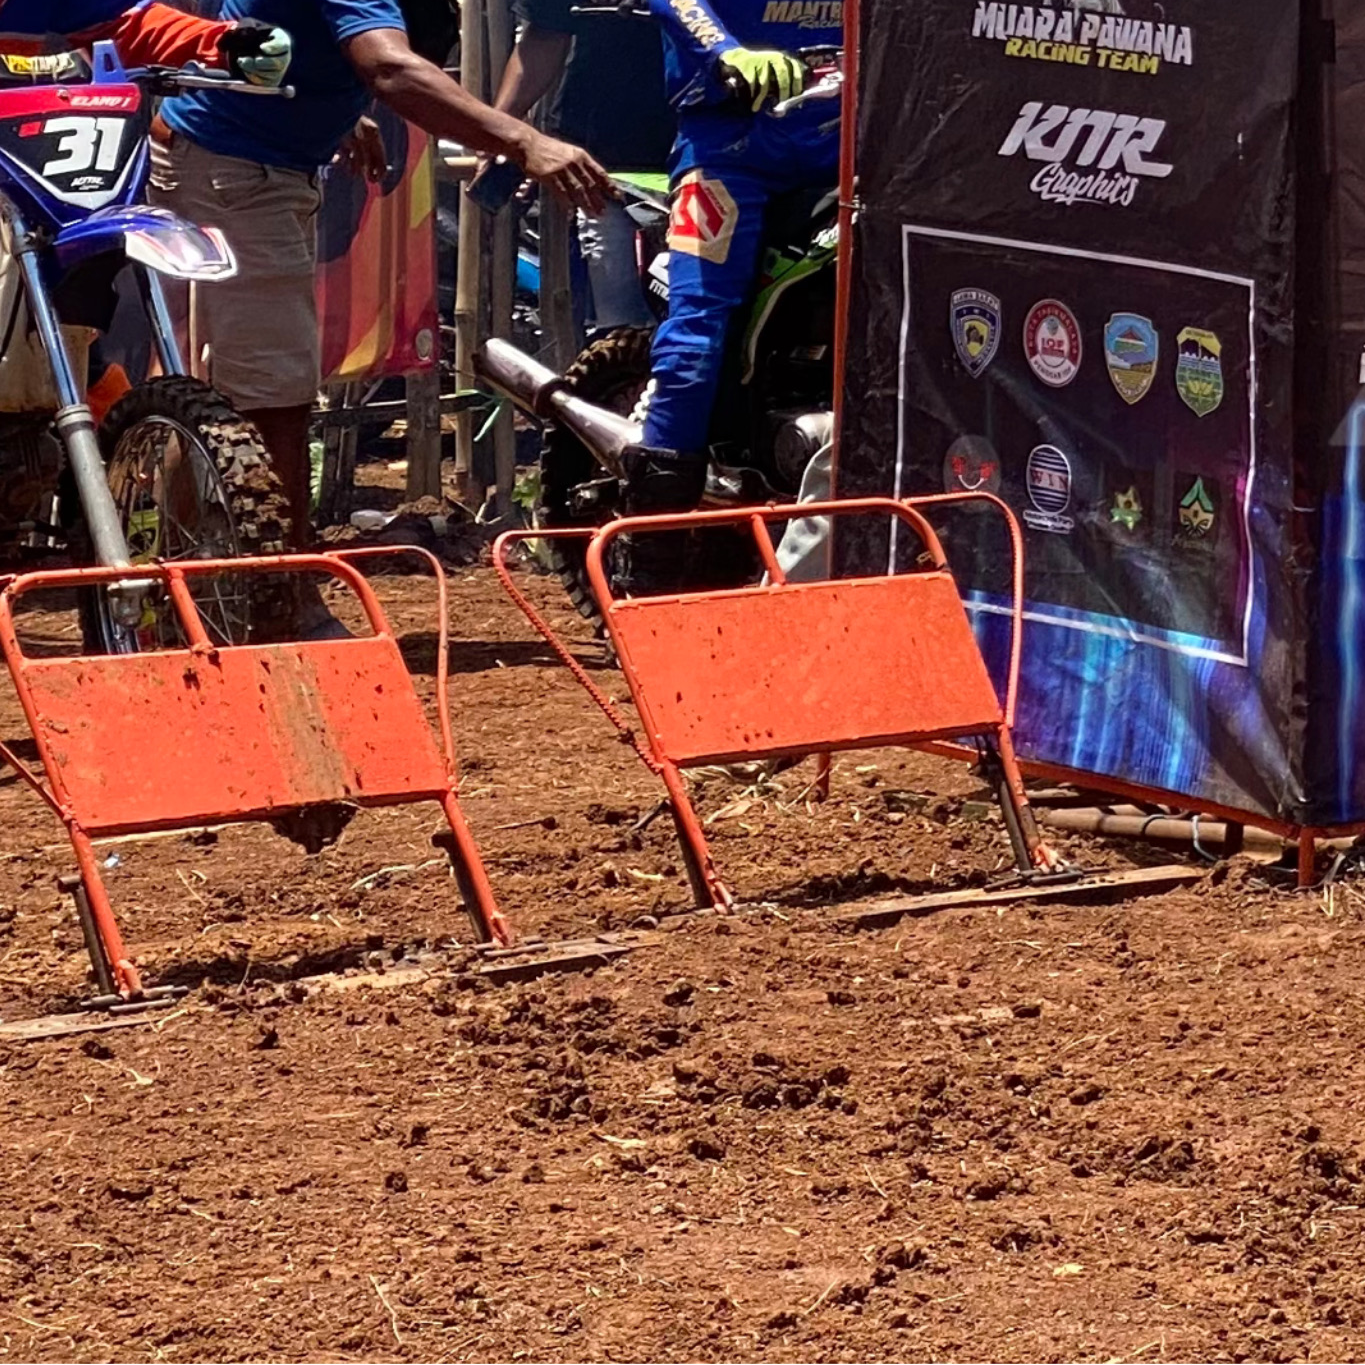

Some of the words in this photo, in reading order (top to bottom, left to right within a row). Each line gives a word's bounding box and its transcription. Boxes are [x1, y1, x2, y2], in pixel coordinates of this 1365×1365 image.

[761, 0, 844, 23] MANTR
[972, 0, 1078, 45] MUARA
[1079, 12, 1194, 66] PAWANA
[1004, 36, 1091, 67] RACING
[1096, 47, 1160, 75] TEAM
[42, 116, 126, 177] 31
[1028, 161, 1140, 208] Graphics
